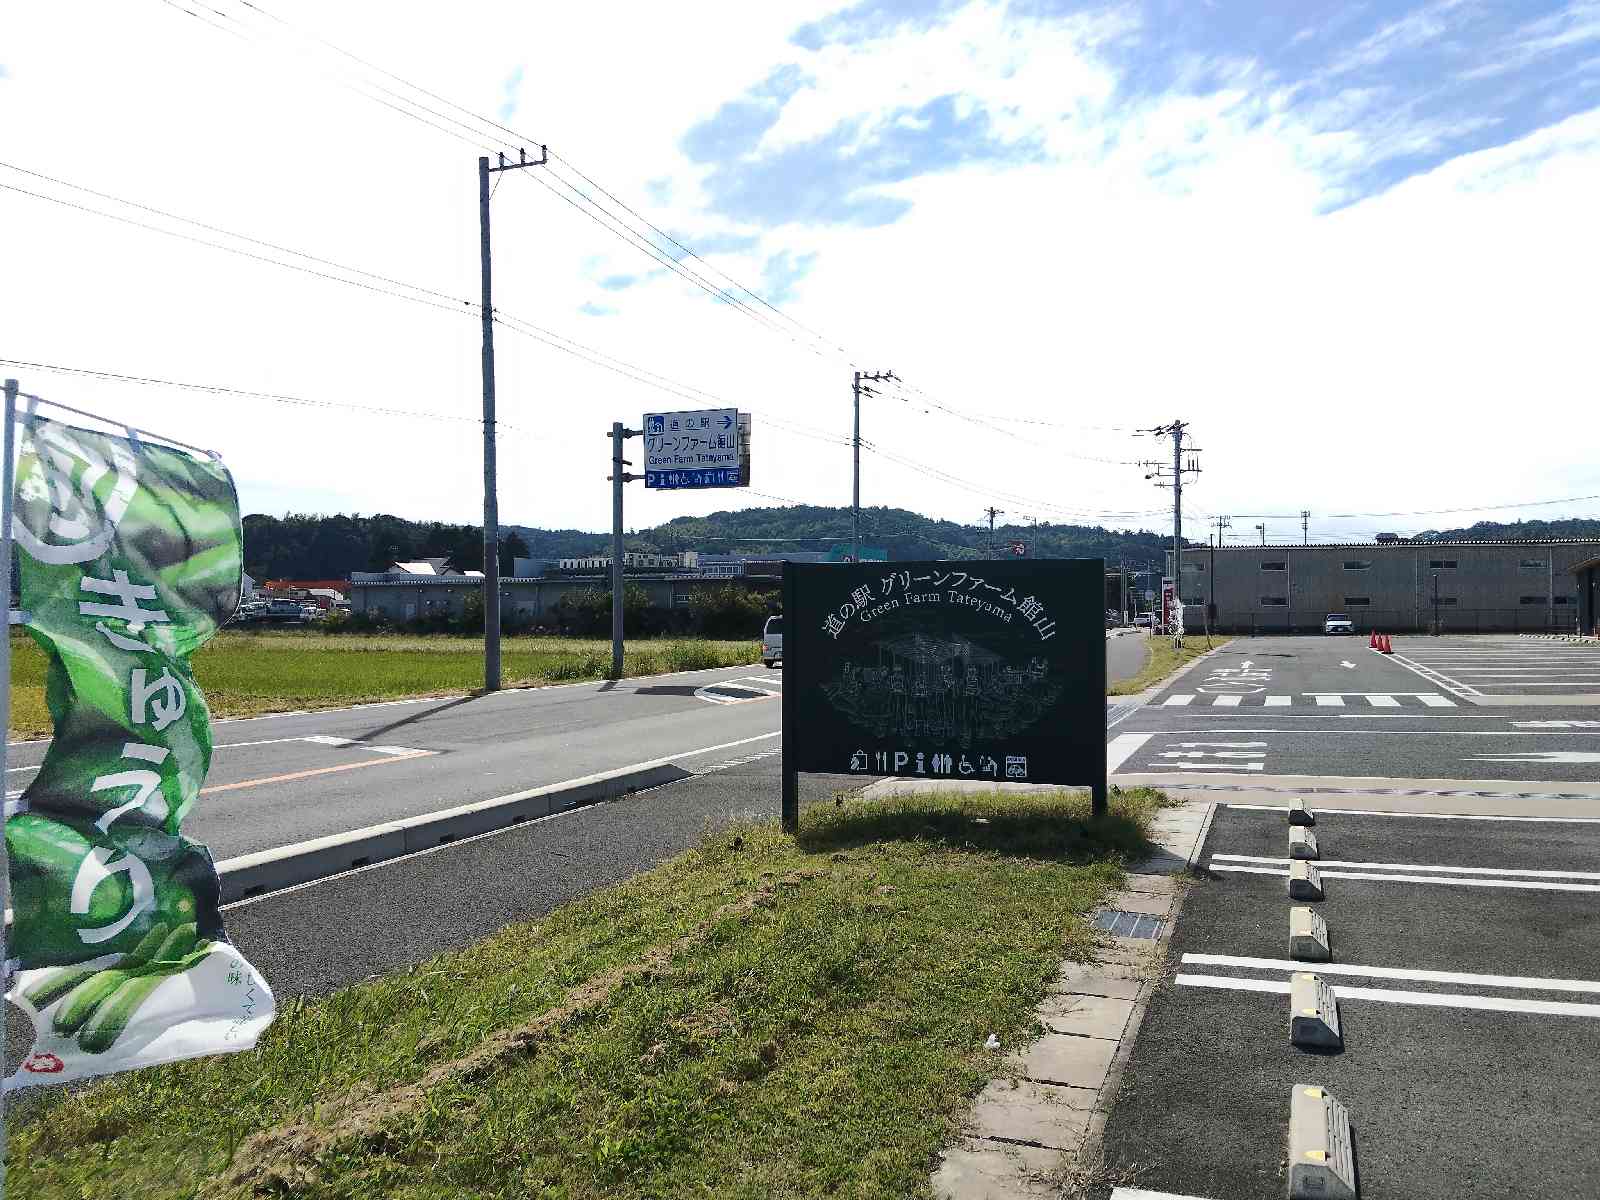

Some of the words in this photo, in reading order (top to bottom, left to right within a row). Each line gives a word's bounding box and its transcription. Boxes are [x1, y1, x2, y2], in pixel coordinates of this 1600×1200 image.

[670, 417, 710, 431] 道の駅
[648, 455, 672, 465] Green
[674, 454, 694, 463] Farm
[696, 453, 735, 463] Tateyama
[822, 584, 875, 640] 道の駅
[860, 599, 900, 622] Green
[904, 592, 941, 604] Farm
[948, 591, 1012, 623] Tateyama
